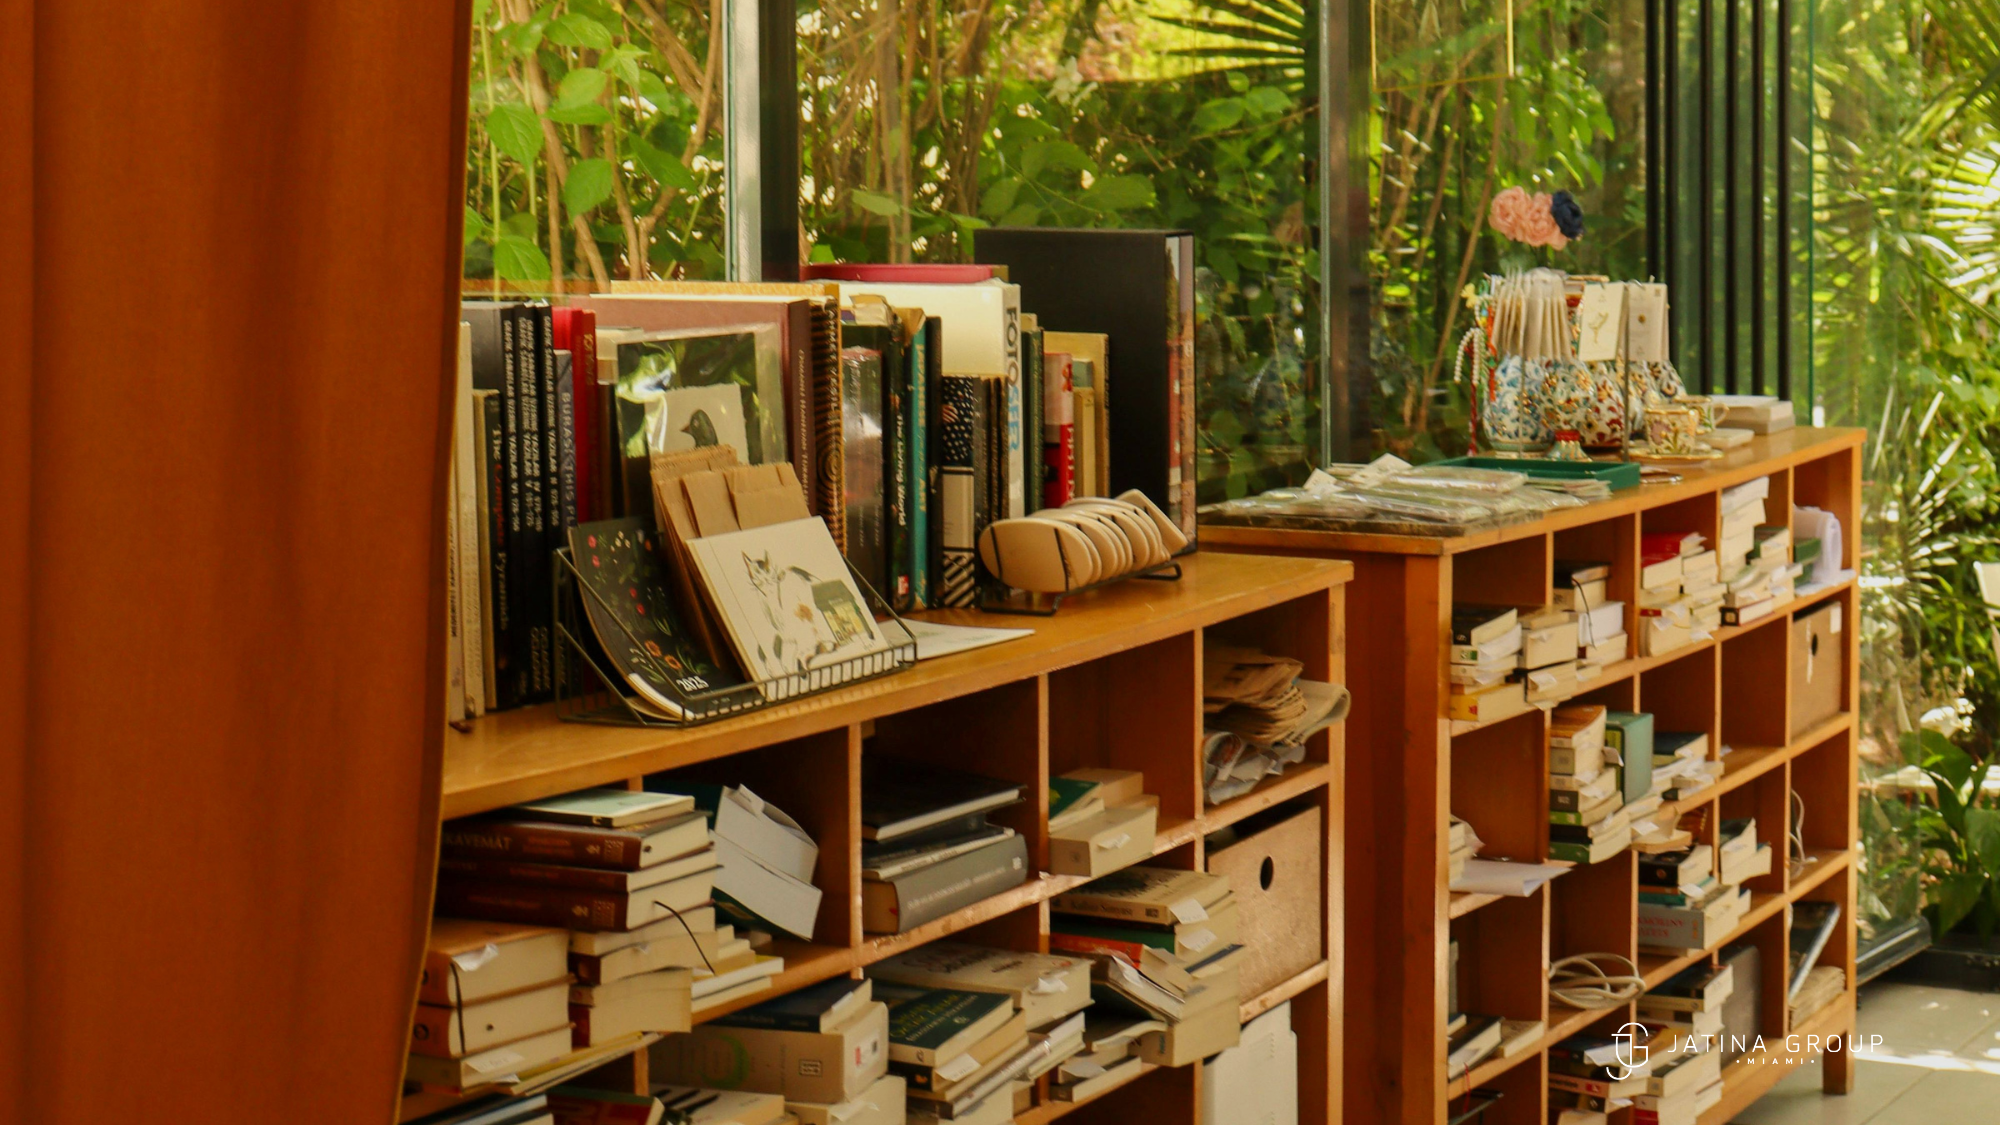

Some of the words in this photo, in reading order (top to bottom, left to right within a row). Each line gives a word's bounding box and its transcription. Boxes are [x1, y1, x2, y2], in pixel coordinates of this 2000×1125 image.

[914, 343, 926, 427] JAPANESE
[491, 423, 503, 461] The
[896, 413, 906, 438] The
[895, 441, 907, 482] Living
[563, 463, 575, 502] THIS
[918, 478, 927, 513] ART
[492, 463, 504, 546] Complete
[897, 485, 908, 526] World
[495, 551, 509, 630] Pyramids
[676, 675, 709, 692] 2025
